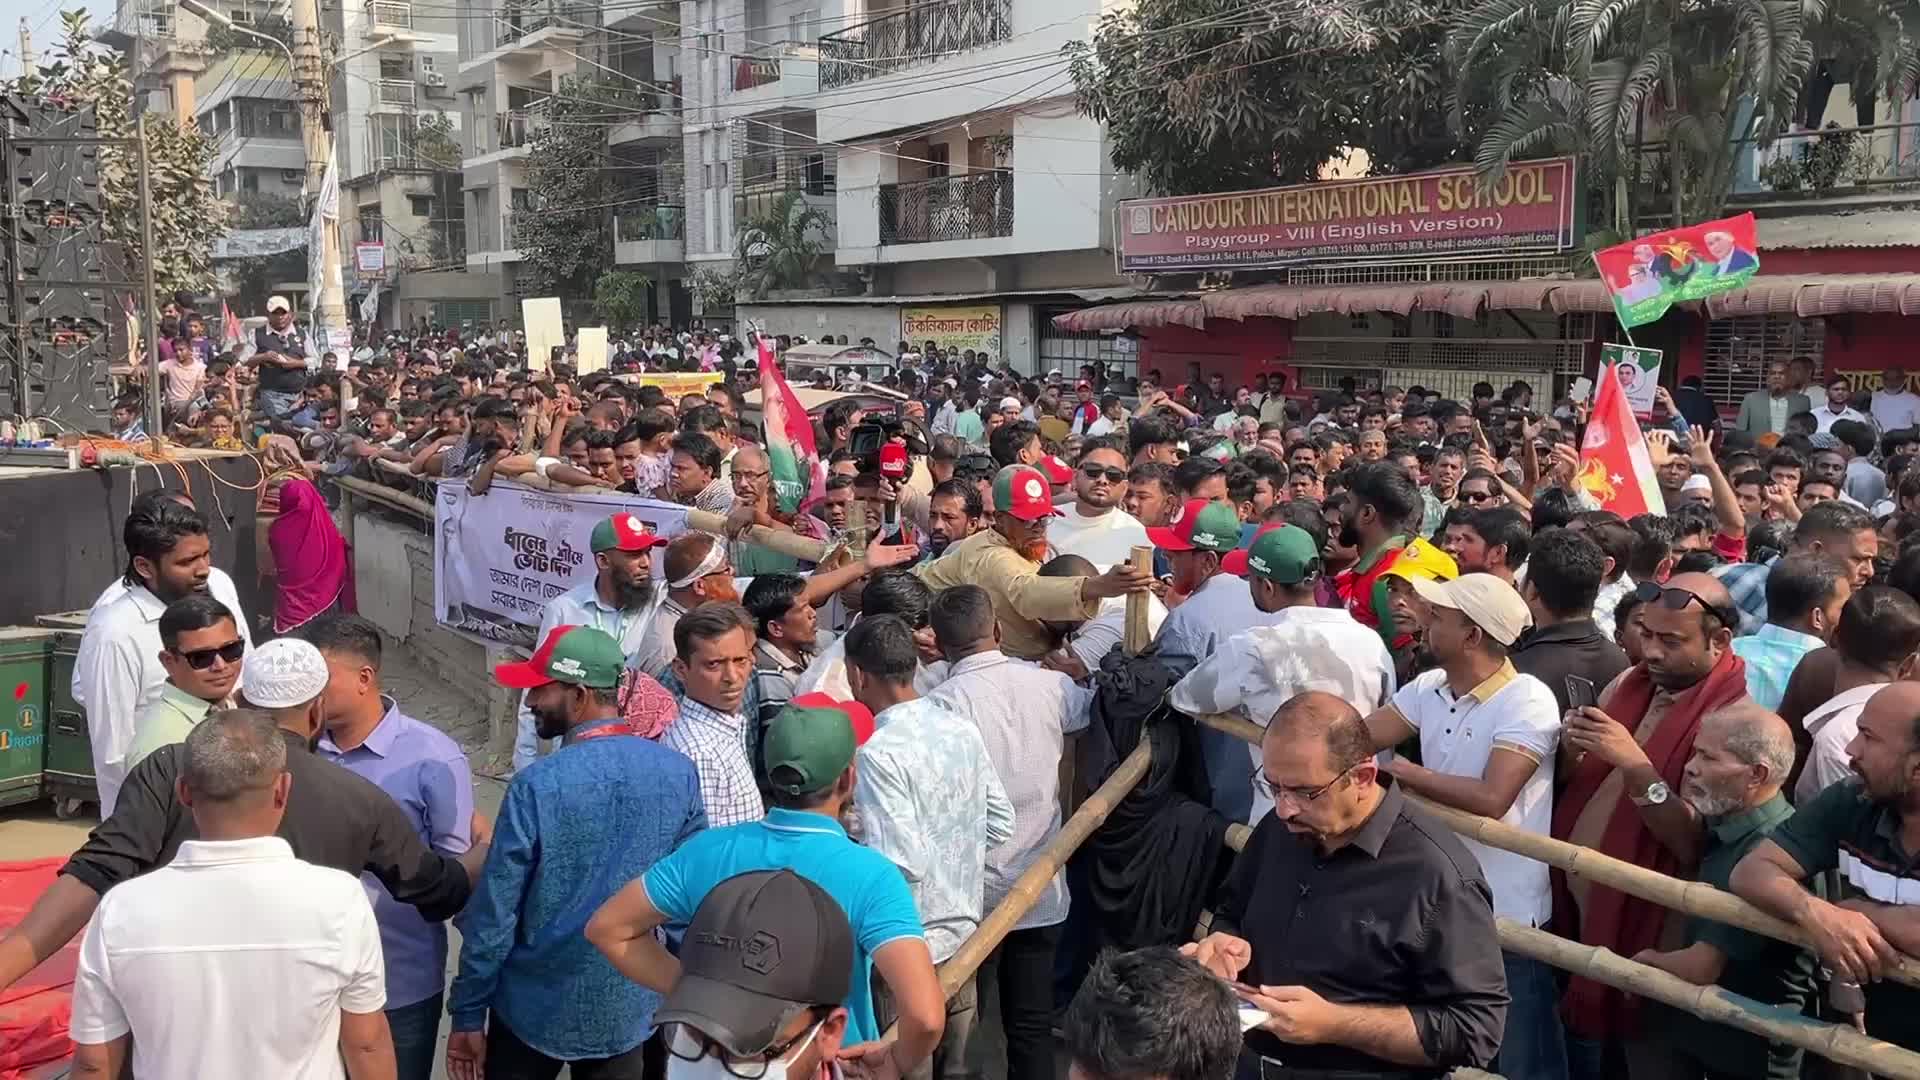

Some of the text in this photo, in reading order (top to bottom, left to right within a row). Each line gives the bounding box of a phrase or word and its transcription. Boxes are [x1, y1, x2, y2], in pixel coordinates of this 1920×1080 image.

[1152, 166, 1553, 234] CANDOUR INTERNATIONAL SCHOOL
[1185, 232, 1270, 249] Playgroup
[1286, 226, 1315, 241] VIII
[1321, 219, 1403, 242] (English
[1408, 212, 1503, 234] Version)
[504, 526, 548, 555] ধানের
[513, 553, 572, 578] ভোট দিন
